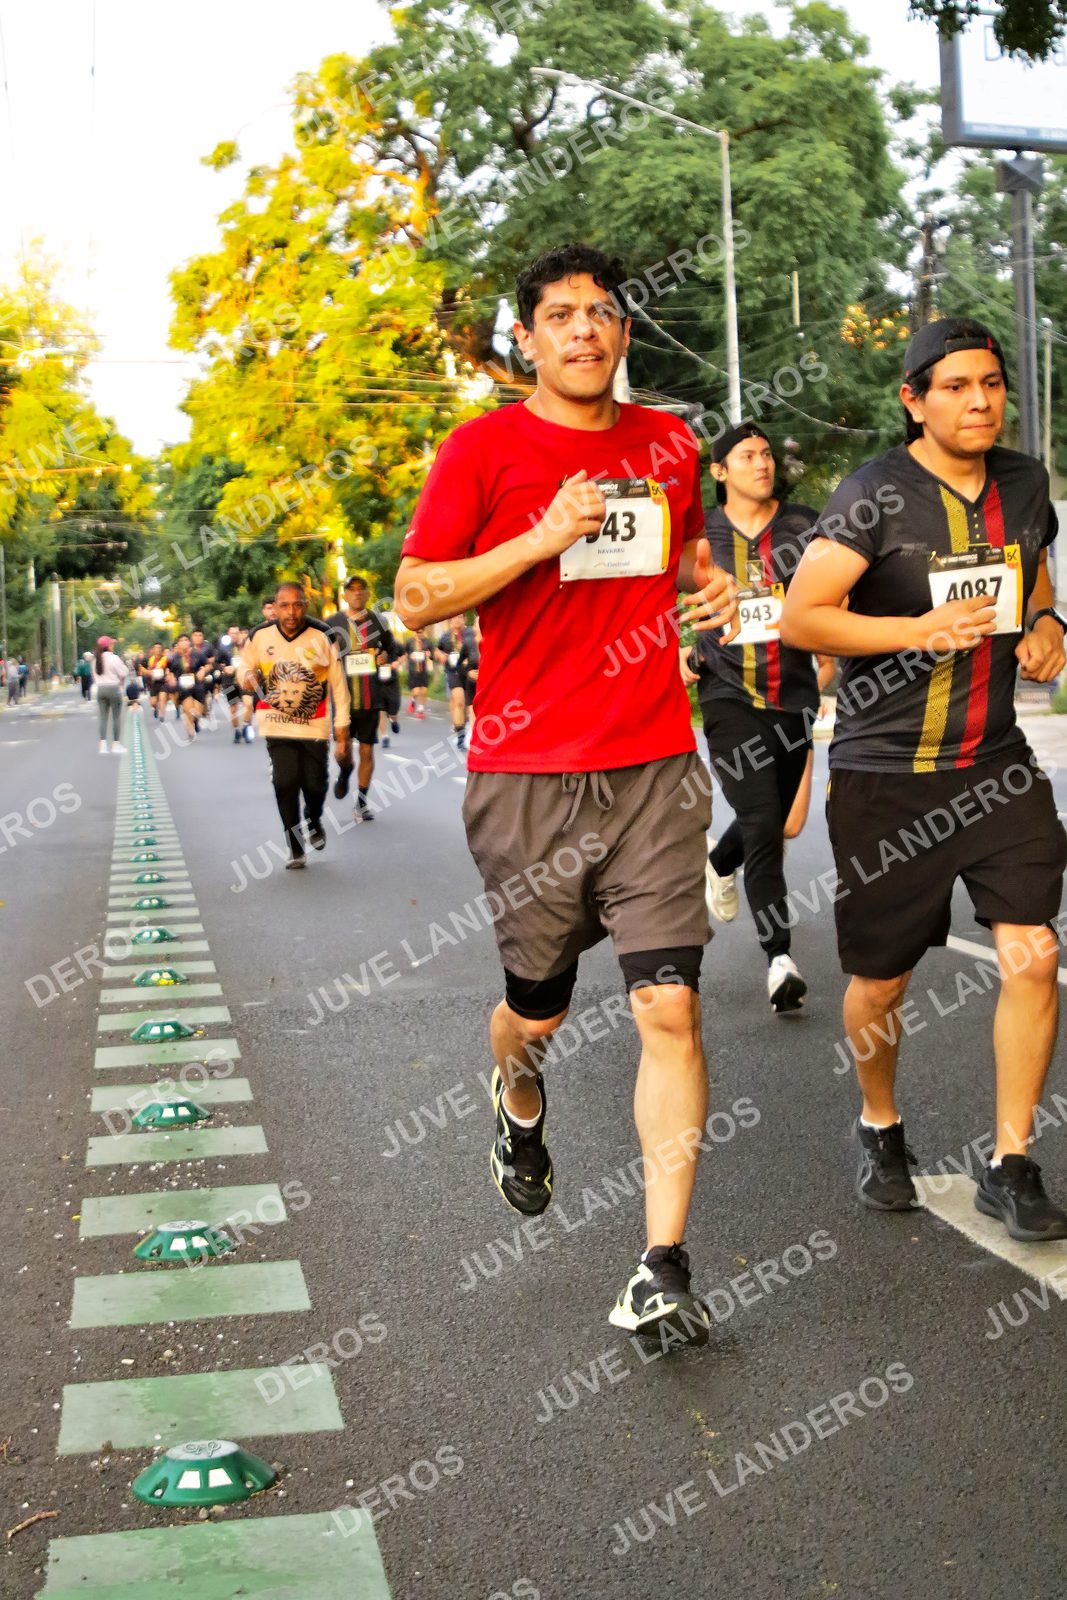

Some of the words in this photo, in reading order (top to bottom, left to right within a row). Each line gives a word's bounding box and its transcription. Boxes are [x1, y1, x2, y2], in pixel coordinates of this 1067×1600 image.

[586, 511, 637, 543] 43
[946, 576, 1003, 603] 4087
[740, 604, 772, 624] 943
